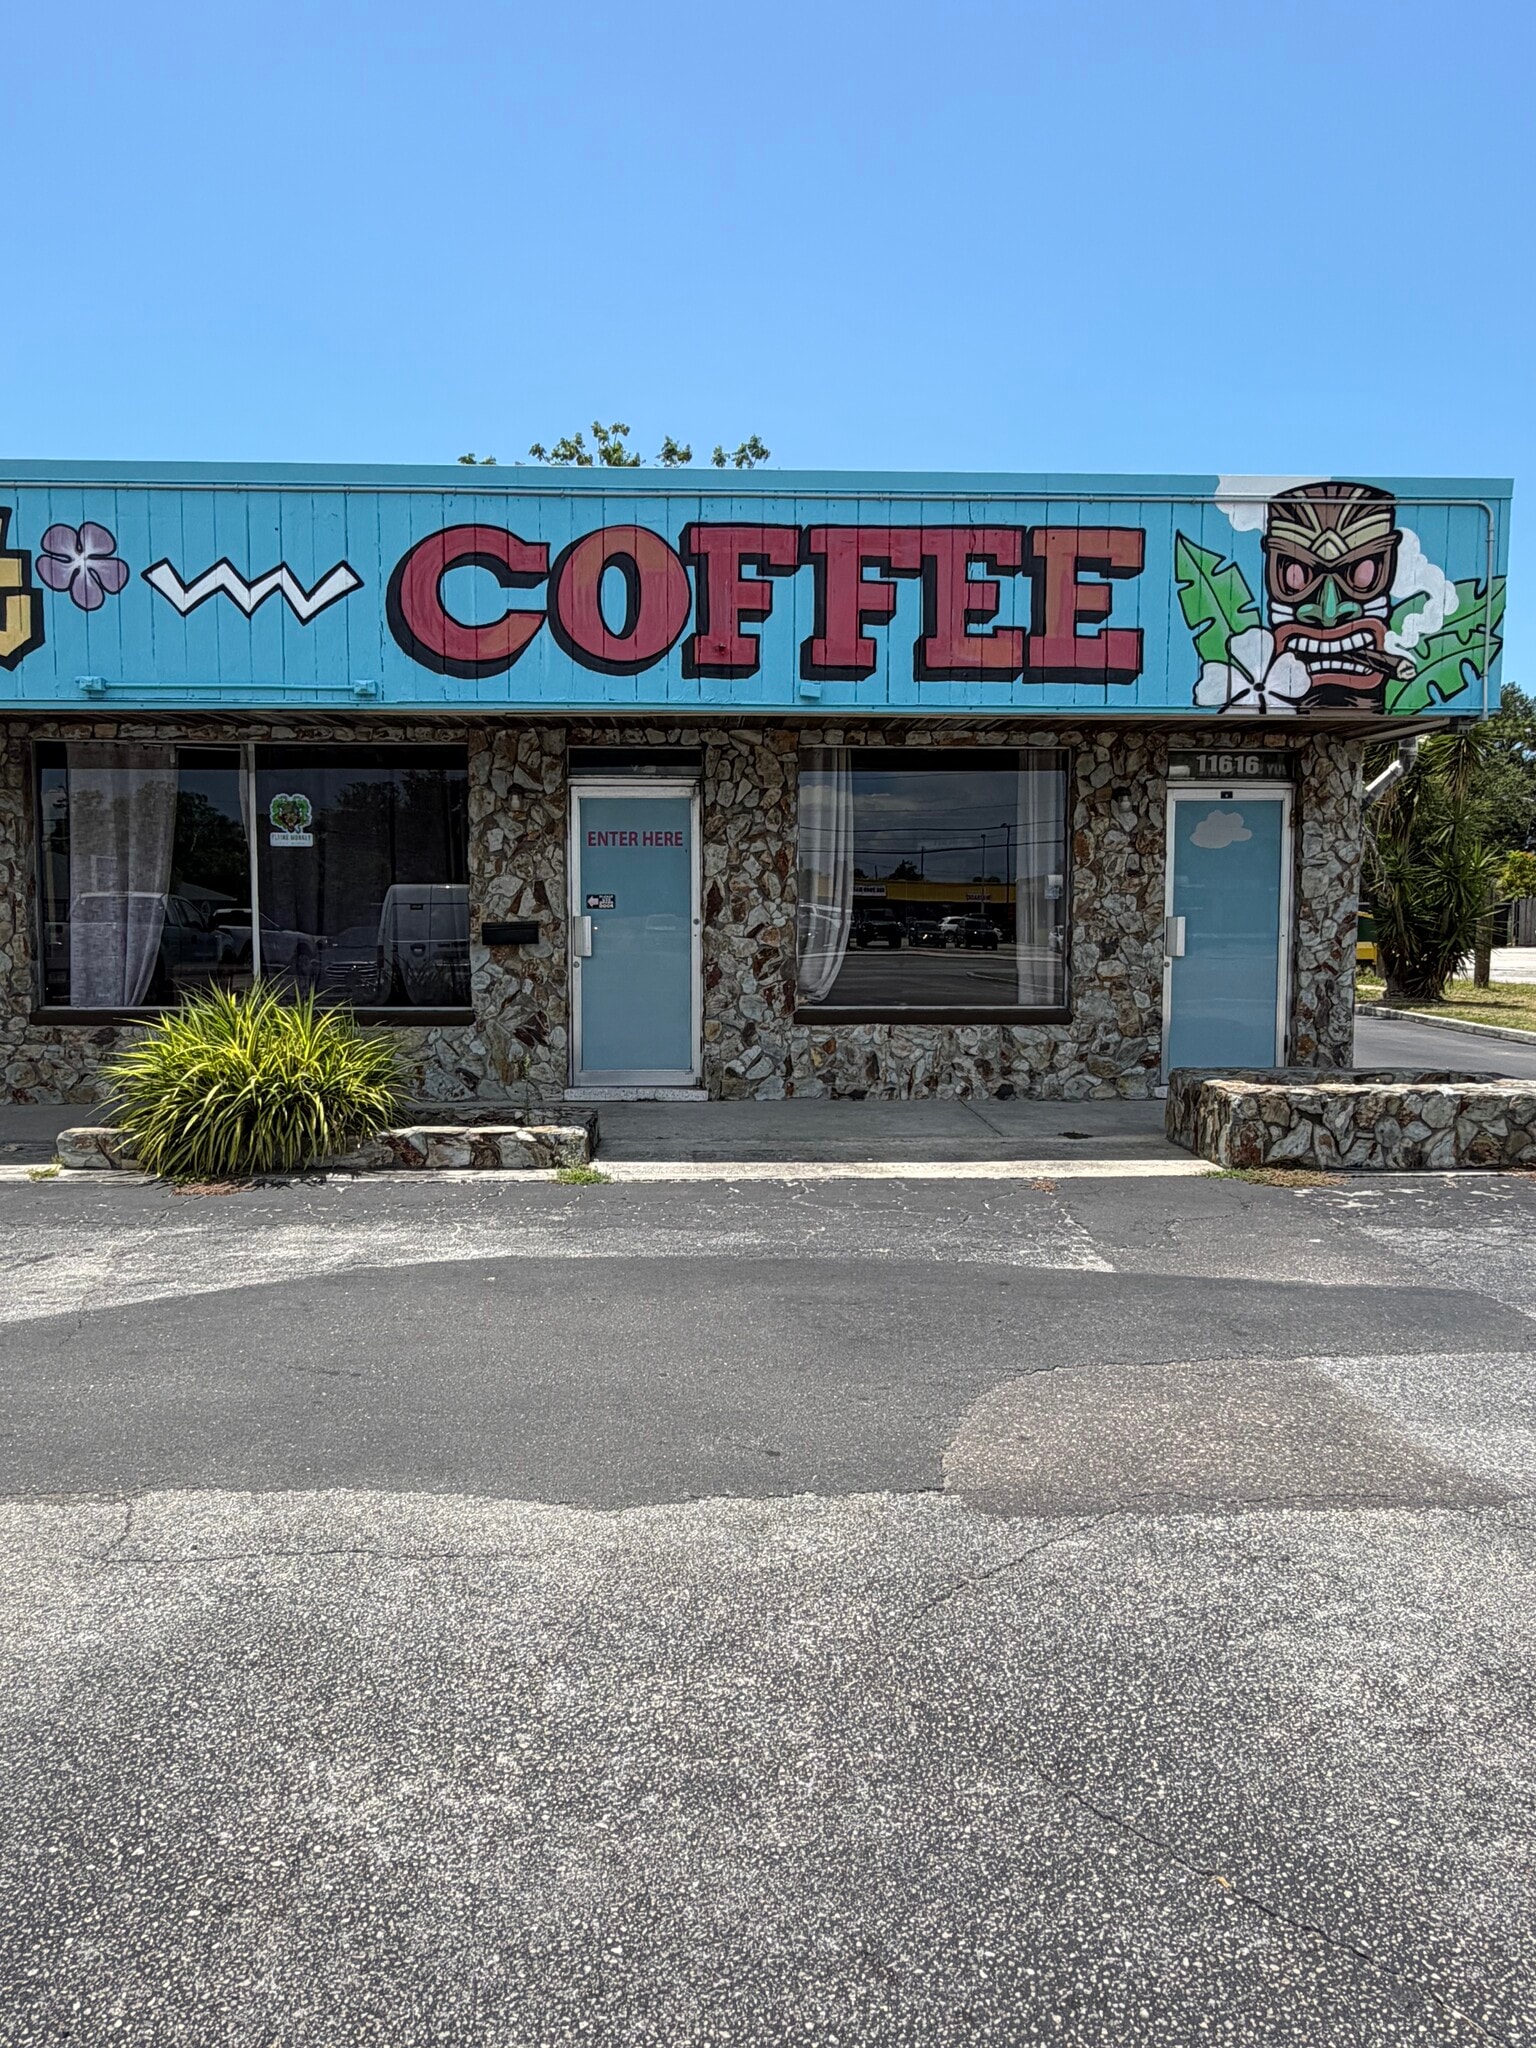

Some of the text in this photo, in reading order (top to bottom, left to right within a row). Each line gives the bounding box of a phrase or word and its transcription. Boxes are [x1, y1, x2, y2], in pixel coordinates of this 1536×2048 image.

[386, 522, 1145, 684] COFFEE
[1196, 754, 1259, 774] 11616
[587, 831, 683, 847] ENTER HERE
